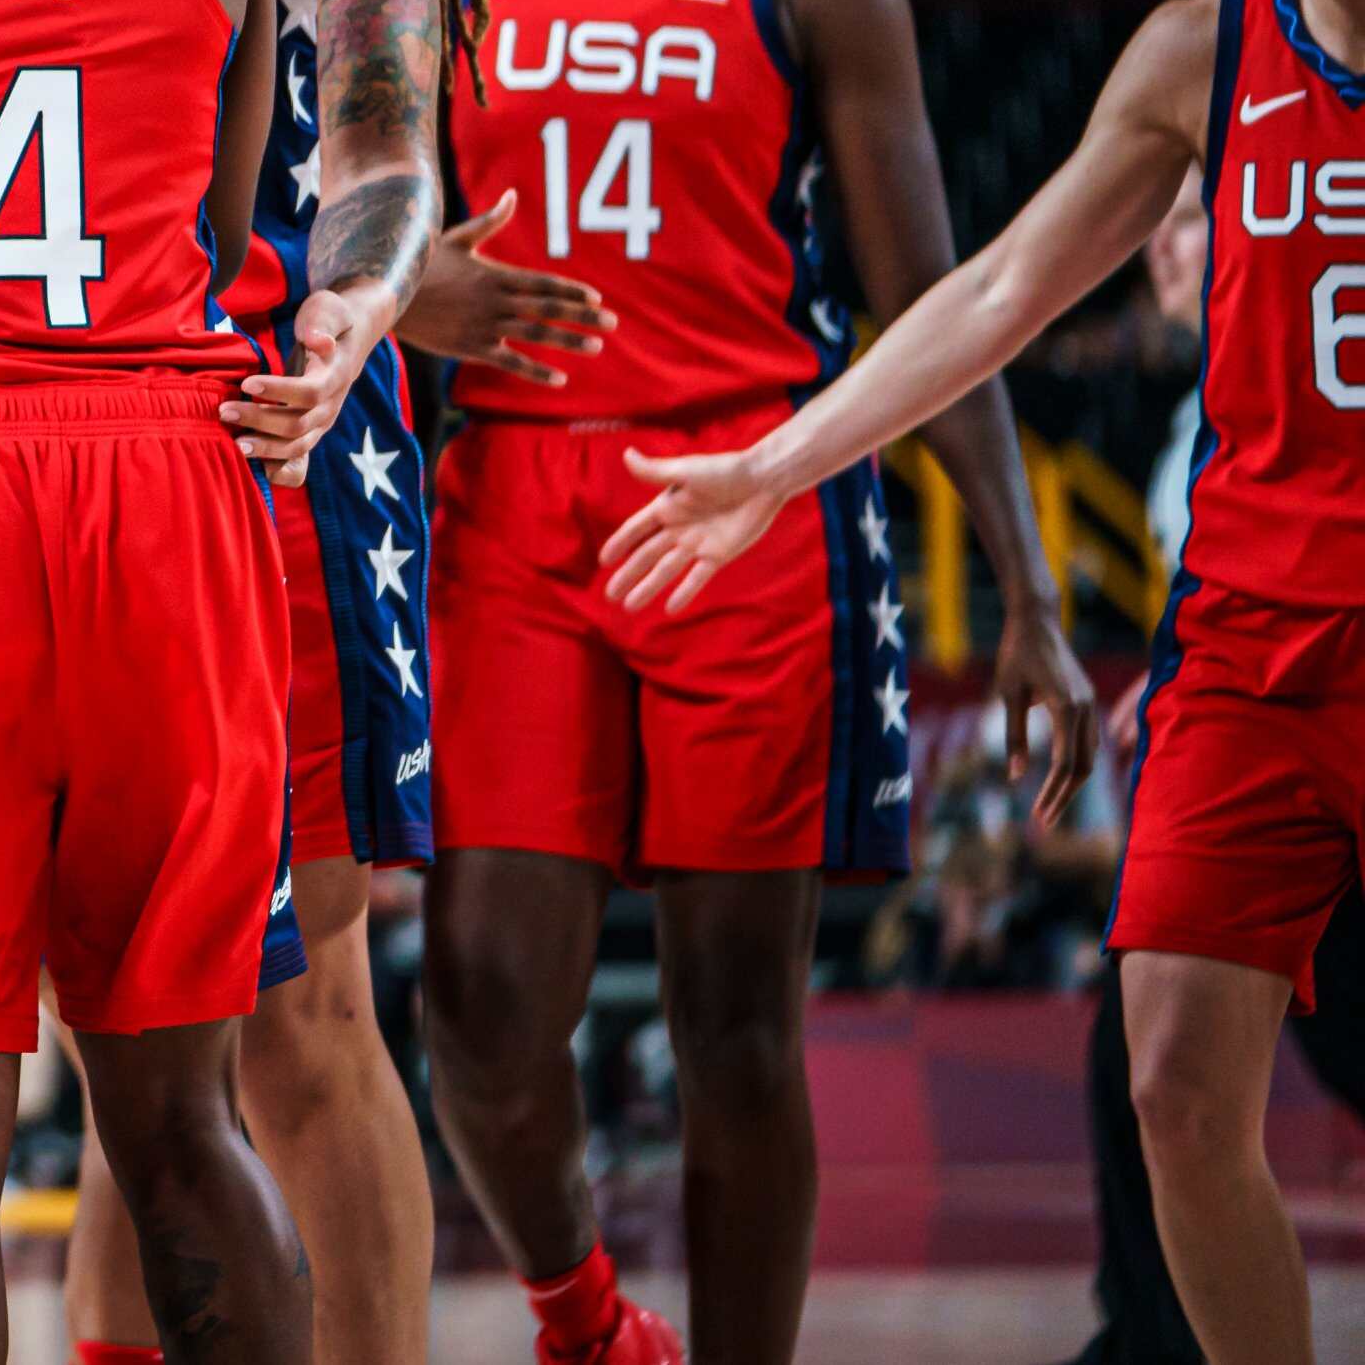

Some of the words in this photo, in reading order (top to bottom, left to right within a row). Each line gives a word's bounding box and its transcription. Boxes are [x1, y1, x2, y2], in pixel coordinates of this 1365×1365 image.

[495, 18, 717, 102] USA
[540, 116, 662, 260] 14
[1241, 159, 1365, 237] US
[1311, 263, 1365, 410] 6
